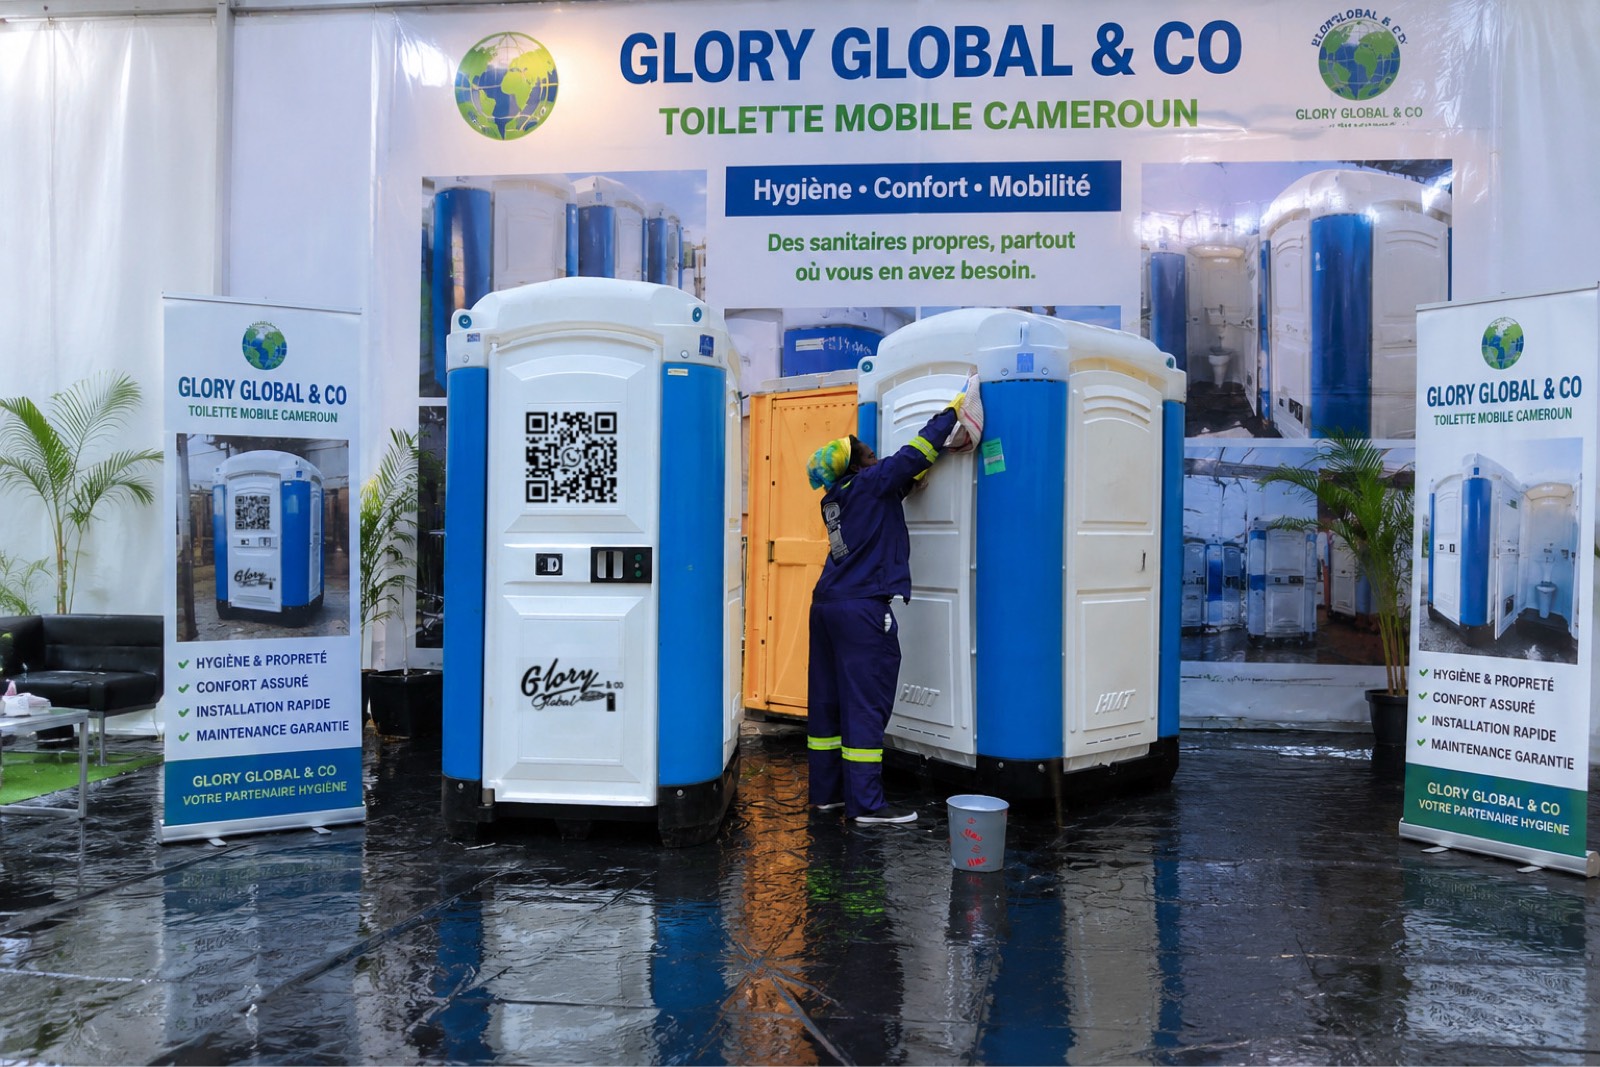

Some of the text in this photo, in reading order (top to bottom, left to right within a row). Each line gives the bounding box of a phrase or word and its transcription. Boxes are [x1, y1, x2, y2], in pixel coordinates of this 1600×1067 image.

[620, 20, 1242, 84] GLORY GLOBAL & CO
[659, 99, 1198, 135] TOILETTE MOBILE CAMEROUN
[1295, 106, 1423, 120] GLORY GLOBAL & CO
[754, 173, 1091, 206] Hygiène Confort Mobilité
[768, 231, 1076, 255] Des sanitaires propres, partout
[795, 259, 1036, 281] où vous en avez besoin.
[178, 376, 348, 405] GLORY GLOBAL & CO
[1427, 375, 1583, 407] GLORY GLOBAL & CO
[188, 405, 339, 423] TOILETTE MOBILE CAMEROUN
[1434, 407, 1573, 426] TOILETTE MOBILE CAMEROUN
[196, 650, 328, 669] HYGIÈNE & PROPRETÉ
[196, 674, 309, 693] CONFORT ASSURÉ
[520, 657, 600, 697] Glory
[1433, 668, 1555, 692] HYGIÈNE & PROPRETÉ
[196, 698, 331, 717] INSTALLATION RAPIDE
[1432, 692, 1536, 714] CONFORT ASSURÉ
[196, 720, 350, 742] MAINTENANCE GARANTIE
[1431, 715, 1557, 742] INSTALLATION RAPIDE
[1431, 738, 1575, 770] MAINTENANCE GARANTIE
[192, 764, 337, 788] GLORY GLOBAL & CO
[183, 793, 222, 806] VOTRE
[225, 785, 296, 802] PARTENAIRE
[1427, 782, 1561, 817] GLORY GLOBAL & CO
[1418, 799, 1452, 814] VOTRE
[1453, 804, 1519, 827] PARTENAIRE
